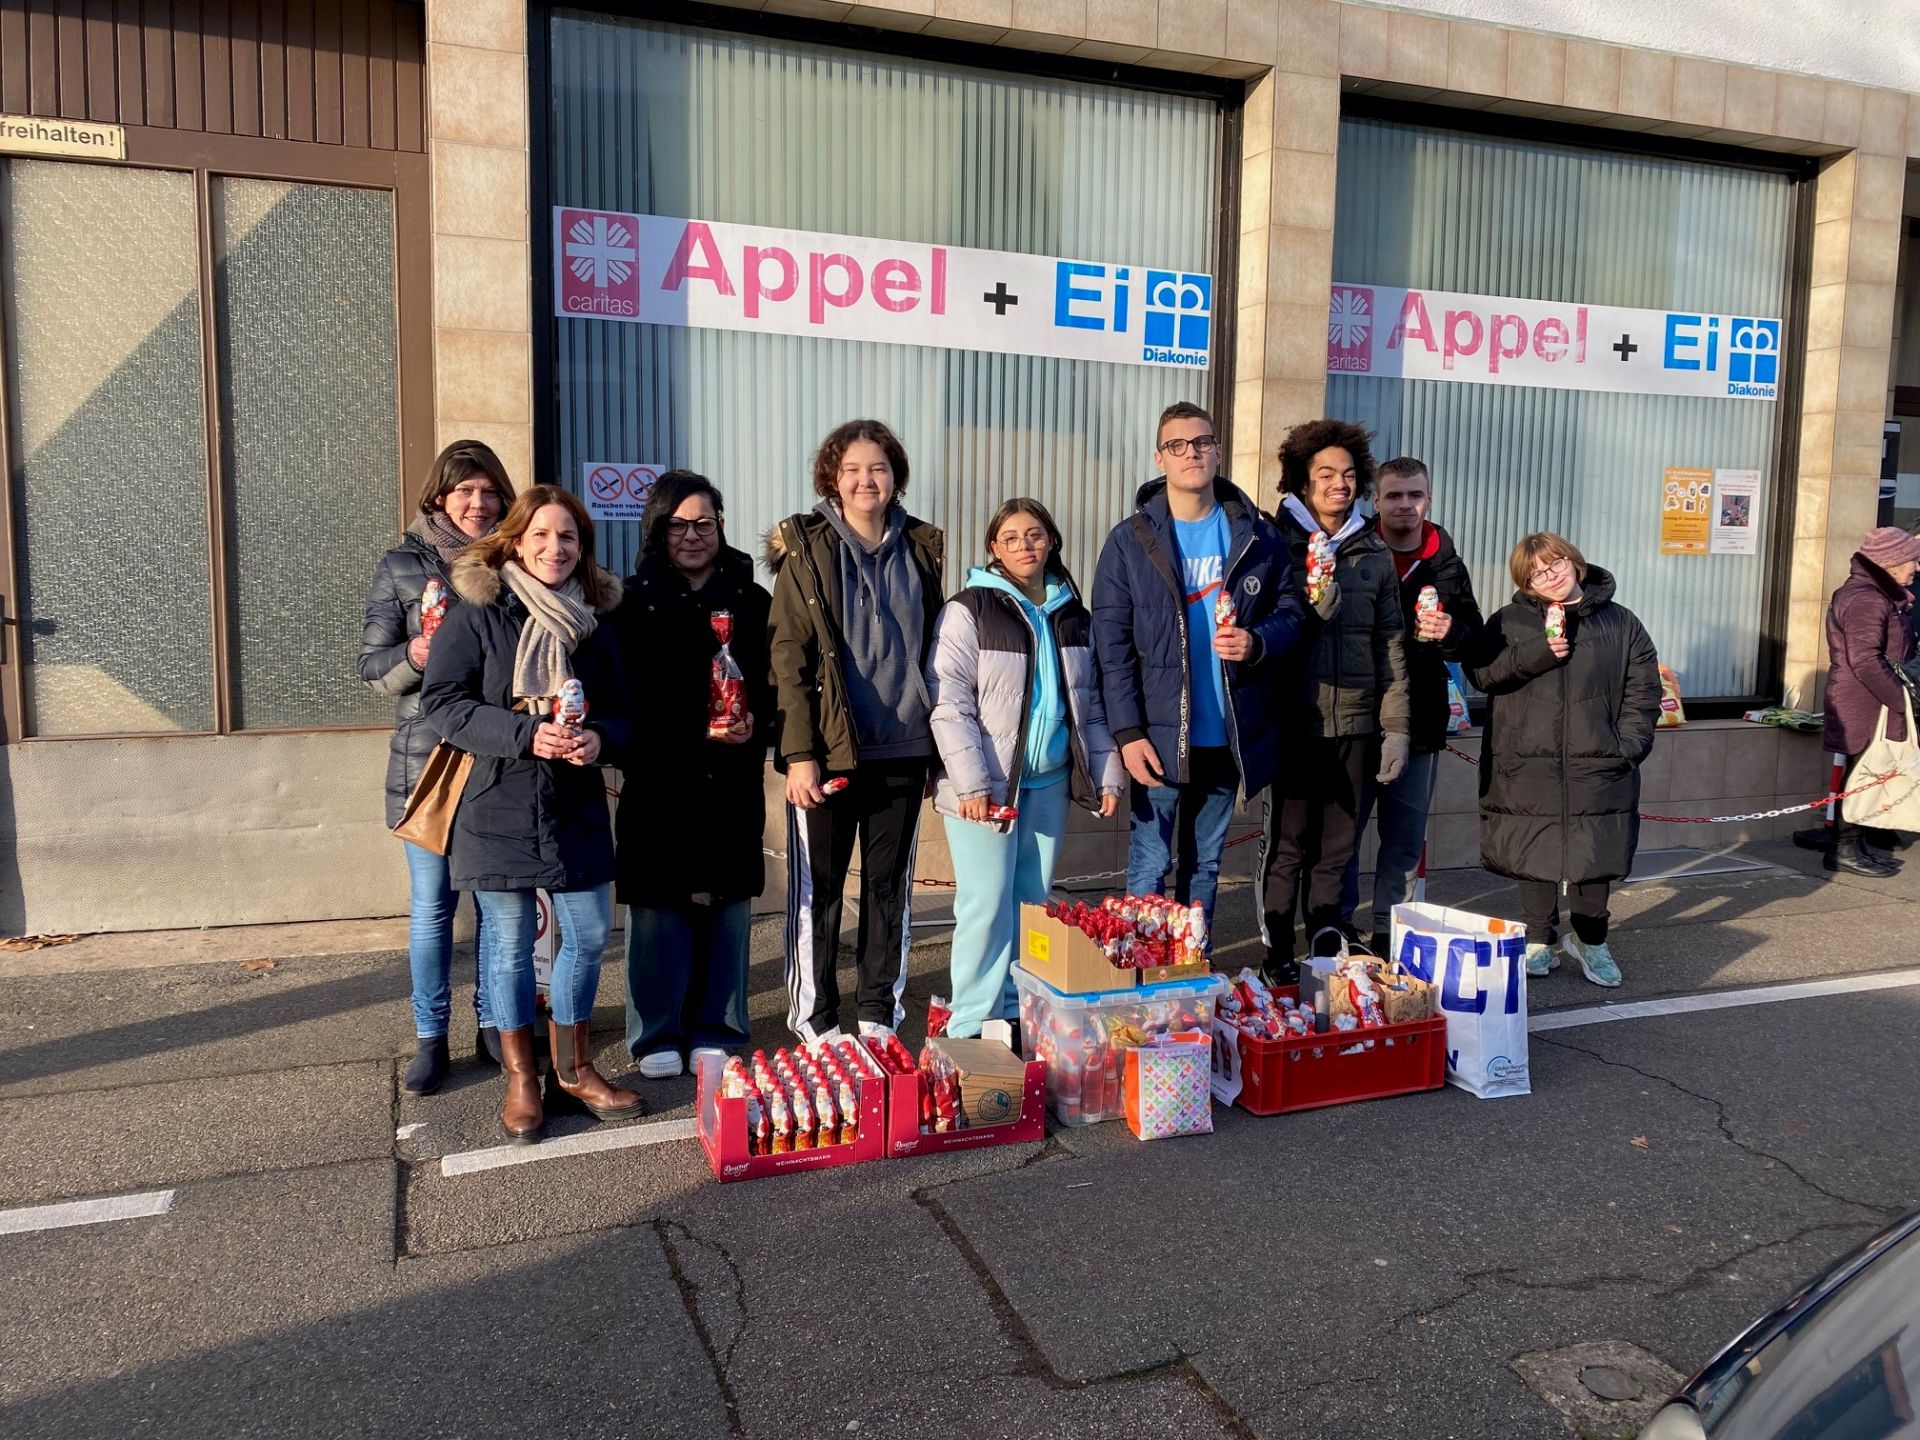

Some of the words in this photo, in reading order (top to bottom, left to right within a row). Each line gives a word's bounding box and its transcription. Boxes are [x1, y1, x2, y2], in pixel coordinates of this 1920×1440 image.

[660, 222, 946, 324] Appel
[1055, 261, 1129, 333] Ei
[568, 293, 634, 315] caritas
[1386, 292, 1588, 374] Appel
[1664, 313, 1719, 371] Ei
[1143, 348, 1208, 366] Diakonie
[1727, 383, 1775, 397] Diakonie
[1181, 555, 1222, 587] NIKE
[775, 1154, 831, 1167] WEIHNACHTSMANN
